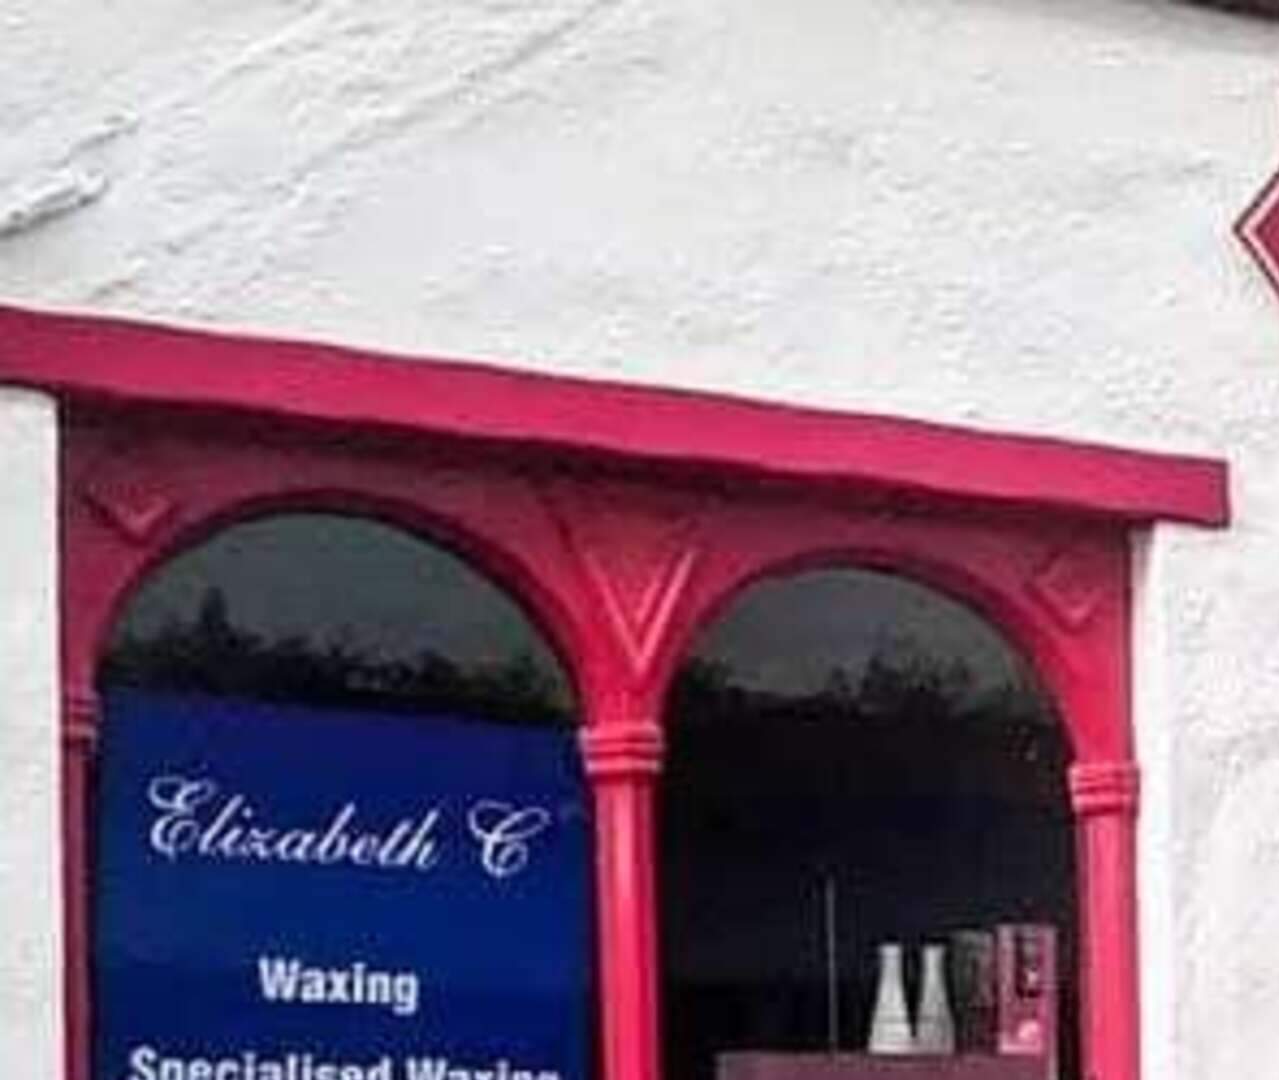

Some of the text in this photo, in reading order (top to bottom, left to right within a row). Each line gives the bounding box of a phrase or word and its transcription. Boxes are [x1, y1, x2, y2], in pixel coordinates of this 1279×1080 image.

[147, 777, 549, 877] Elizabeth C
[258, 956, 420, 1015] Waxing
